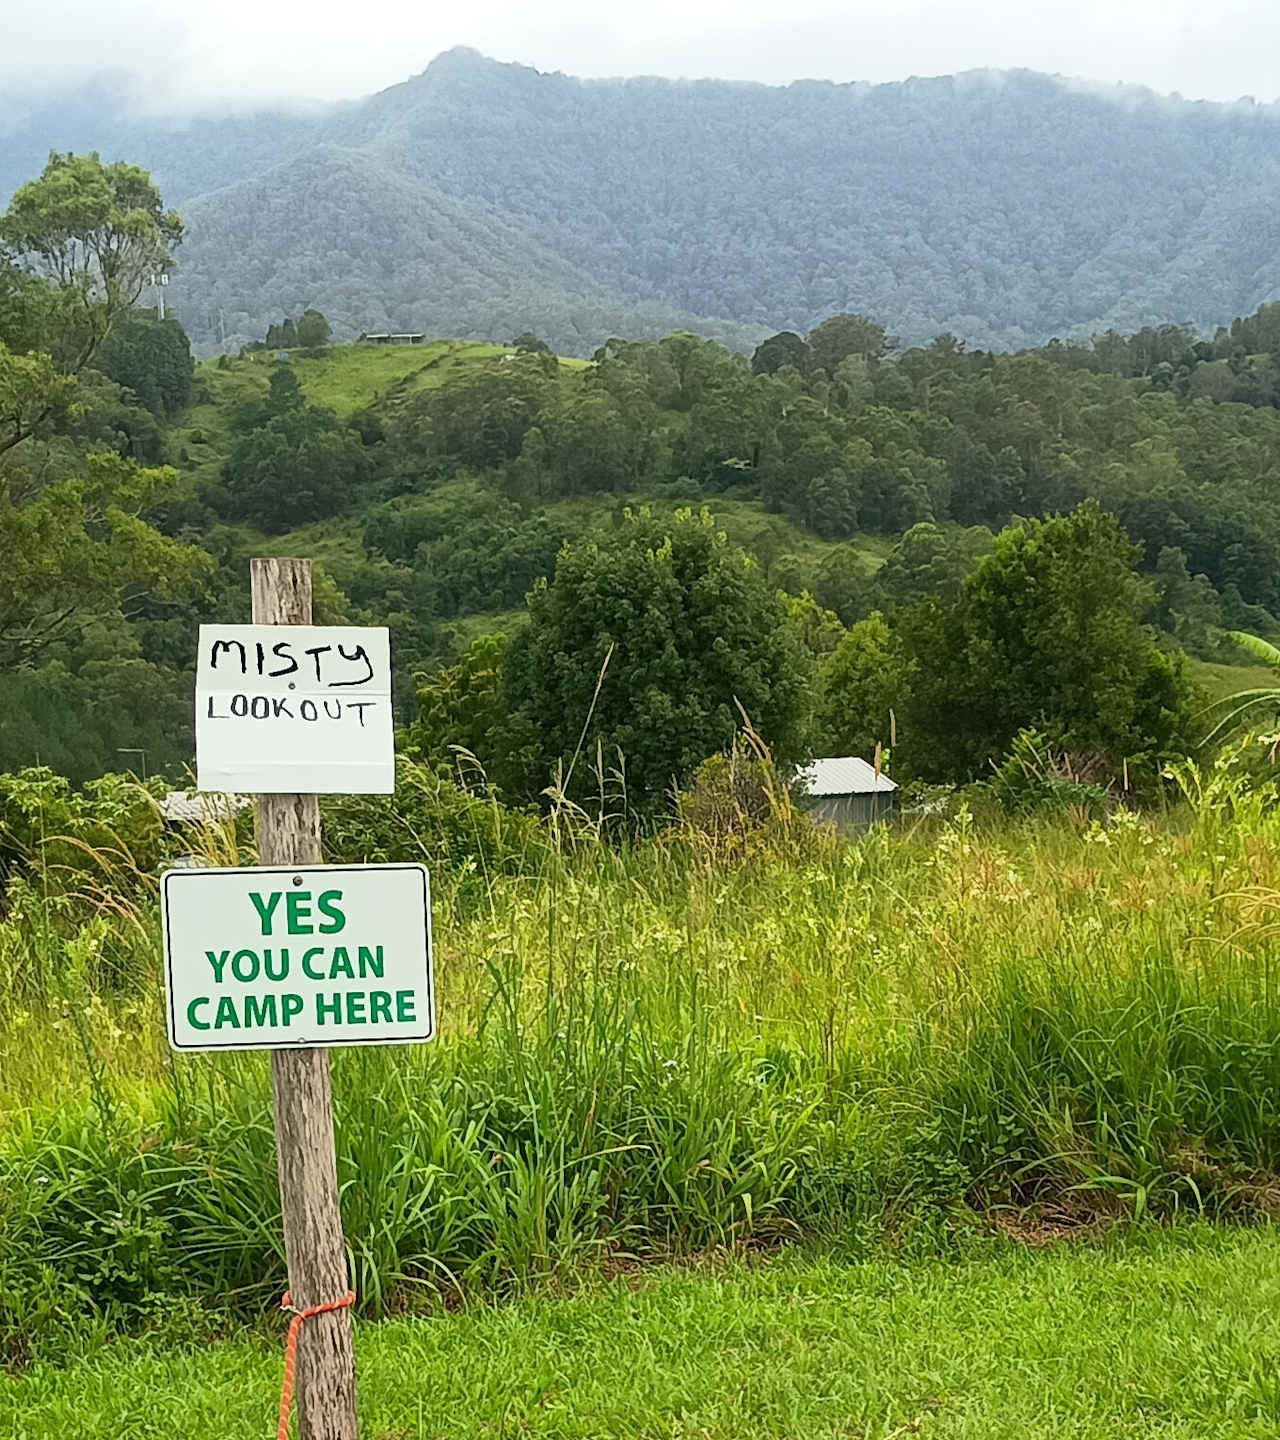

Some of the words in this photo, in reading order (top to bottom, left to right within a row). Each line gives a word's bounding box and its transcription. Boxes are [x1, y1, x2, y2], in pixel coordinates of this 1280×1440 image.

[207, 694, 377, 727] LOOKOUT
[248, 889, 347, 936] YES
[205, 948, 290, 984] YOU
[301, 945, 385, 981] CAN
[186, 993, 304, 1031] CAMP
[315, 989, 417, 1026] HERE
